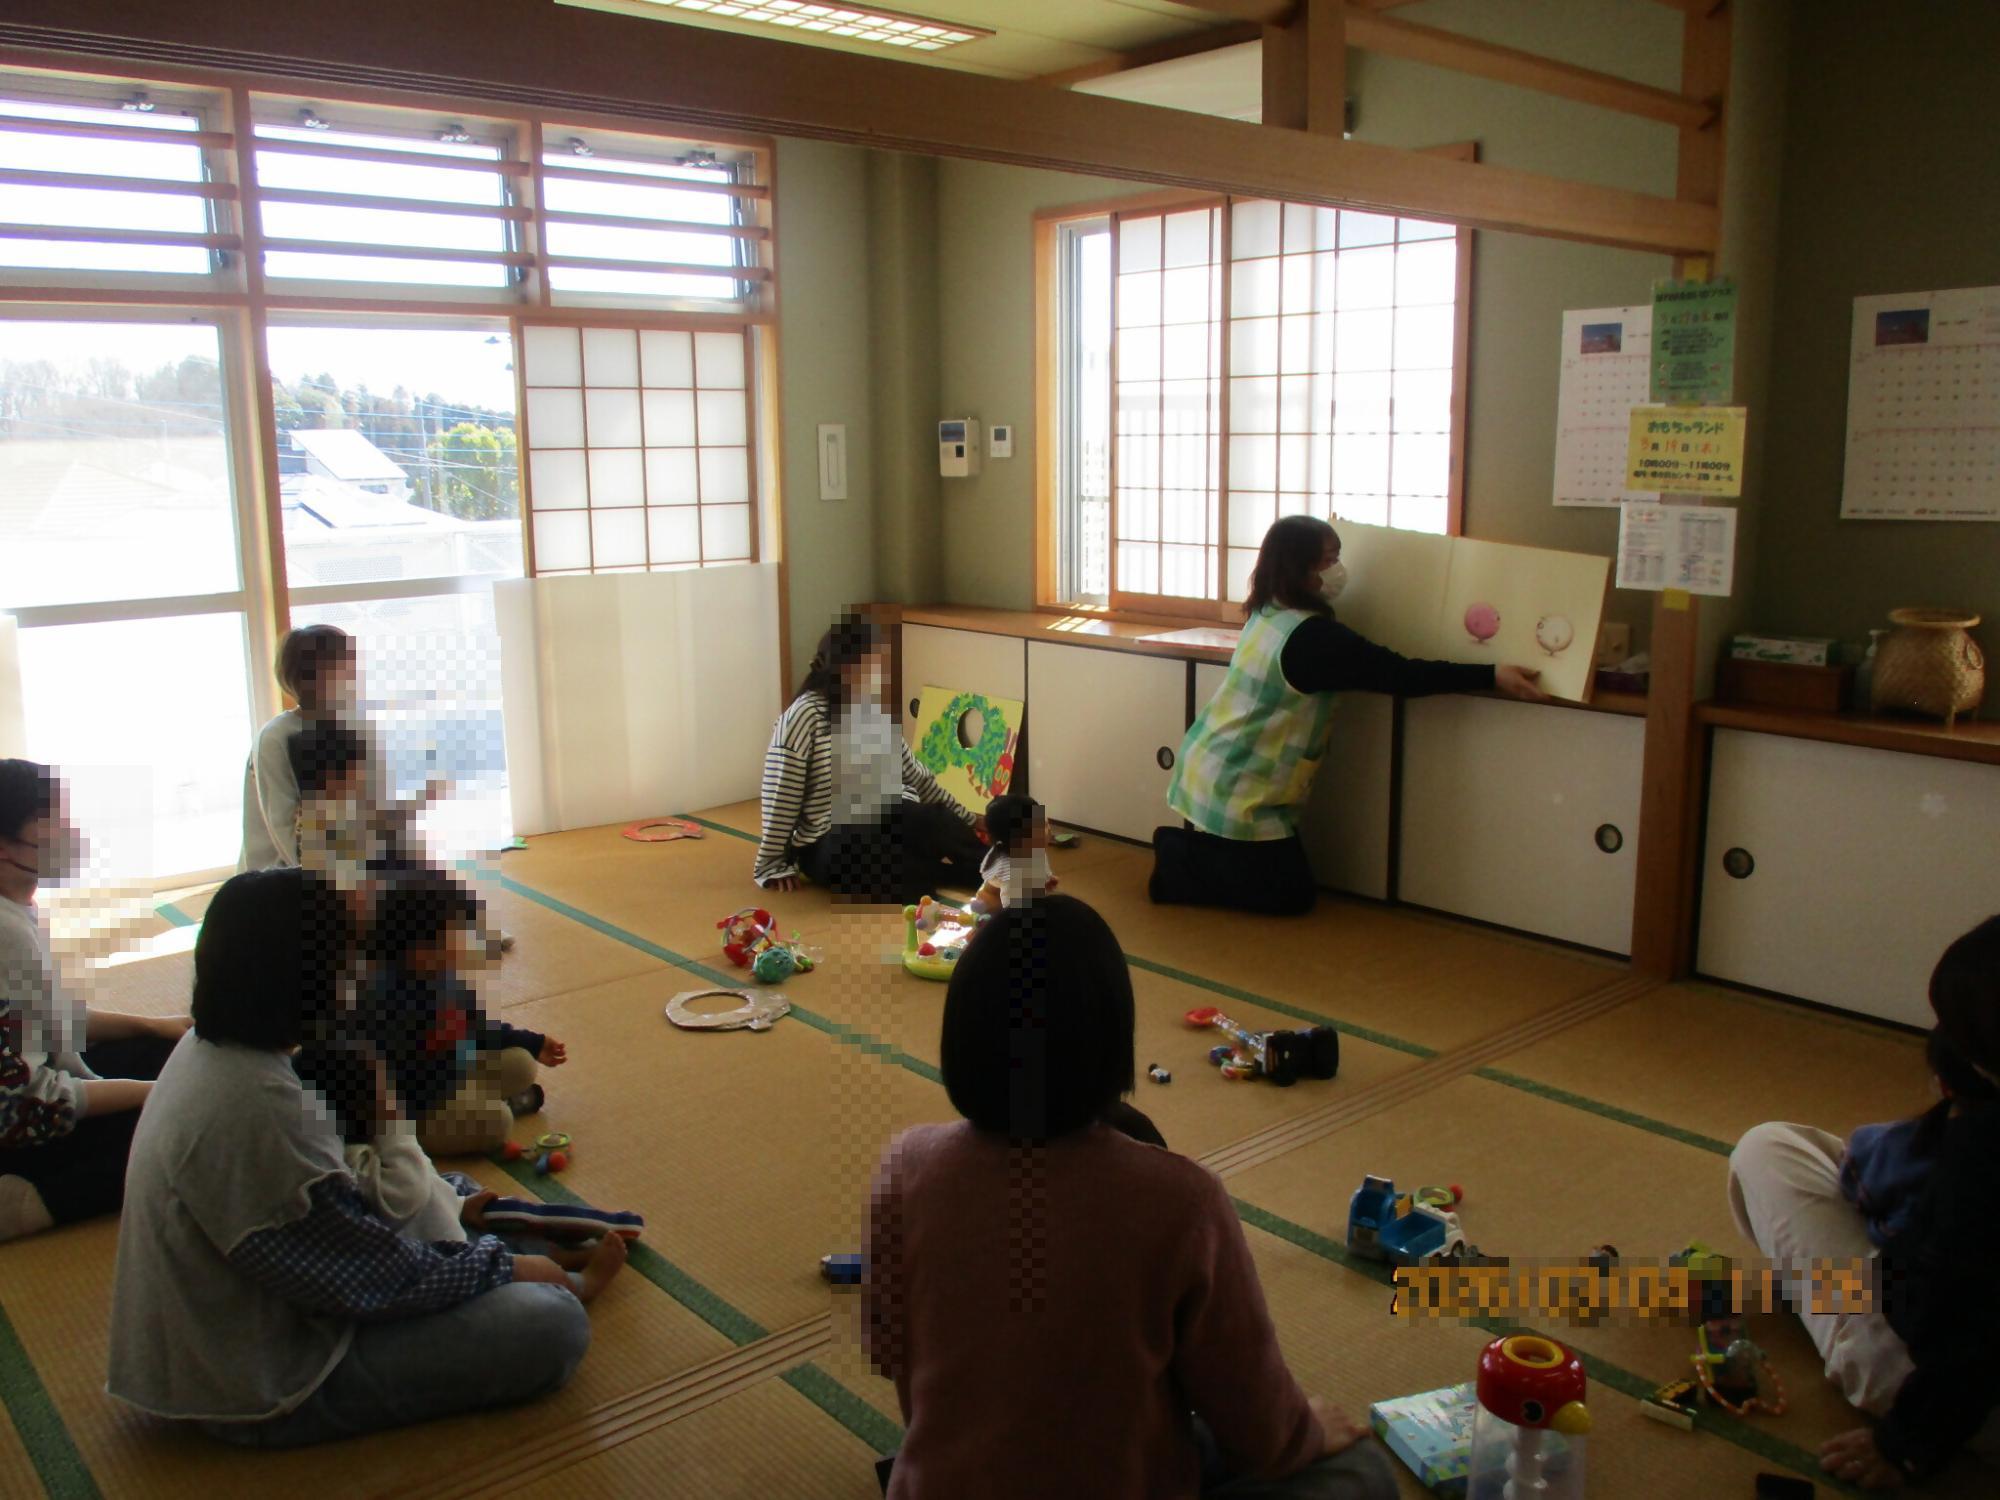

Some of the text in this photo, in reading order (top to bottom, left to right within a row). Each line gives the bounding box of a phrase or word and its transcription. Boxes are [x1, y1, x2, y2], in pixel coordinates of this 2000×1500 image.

[1647, 420, 1725, 435] おもちゃランド
